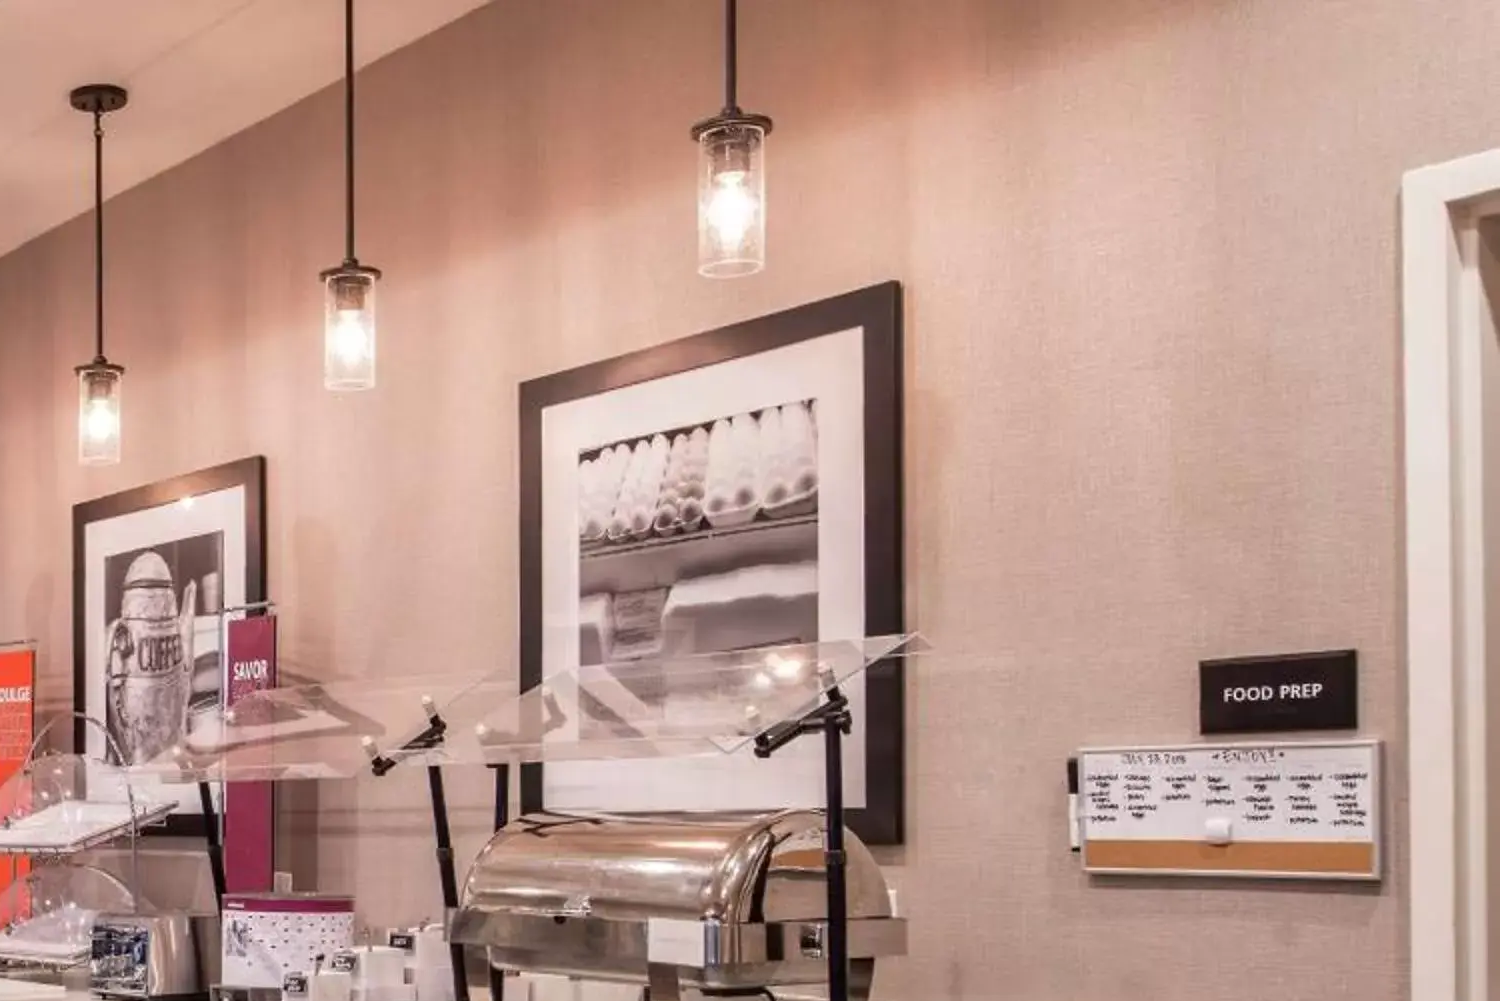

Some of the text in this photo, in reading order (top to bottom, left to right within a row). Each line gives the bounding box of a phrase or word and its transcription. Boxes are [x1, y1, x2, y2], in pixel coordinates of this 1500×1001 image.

[233, 660, 268, 681] SAVOR
[1223, 683, 1323, 702] FOOD PREP
